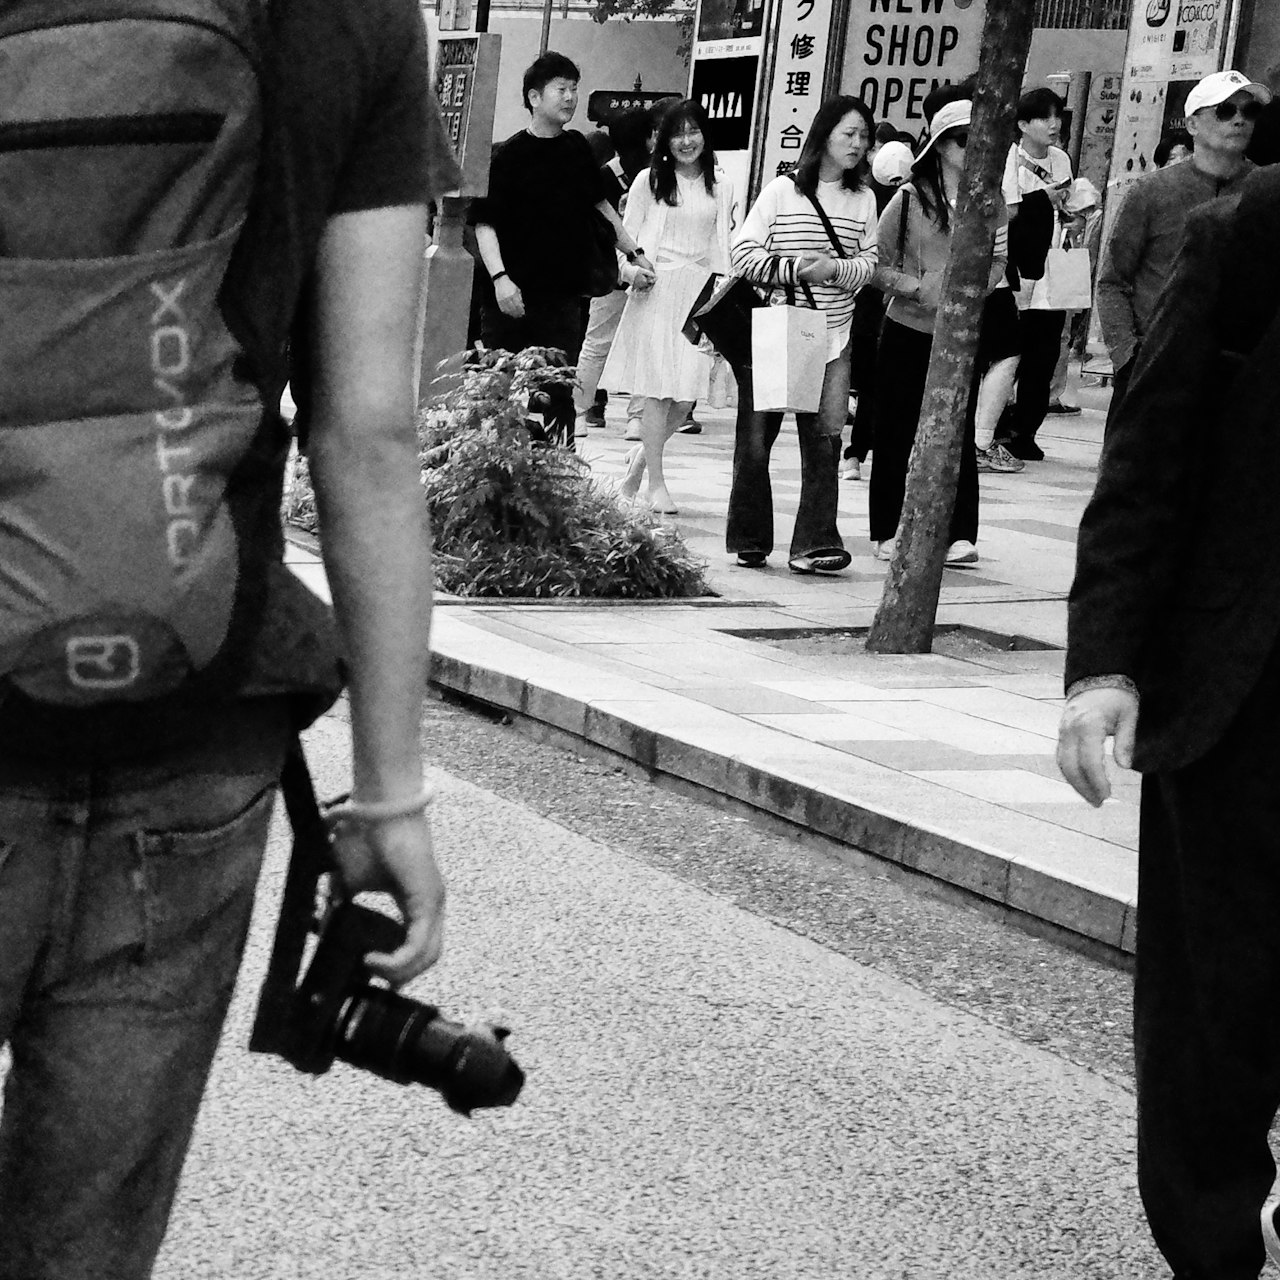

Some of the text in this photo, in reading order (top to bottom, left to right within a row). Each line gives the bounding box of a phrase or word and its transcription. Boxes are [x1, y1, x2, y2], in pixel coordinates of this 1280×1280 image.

[863, 24, 959, 67] SHOP
[701, 91, 743, 119] PLAZA
[860, 77, 951, 119] OPE
